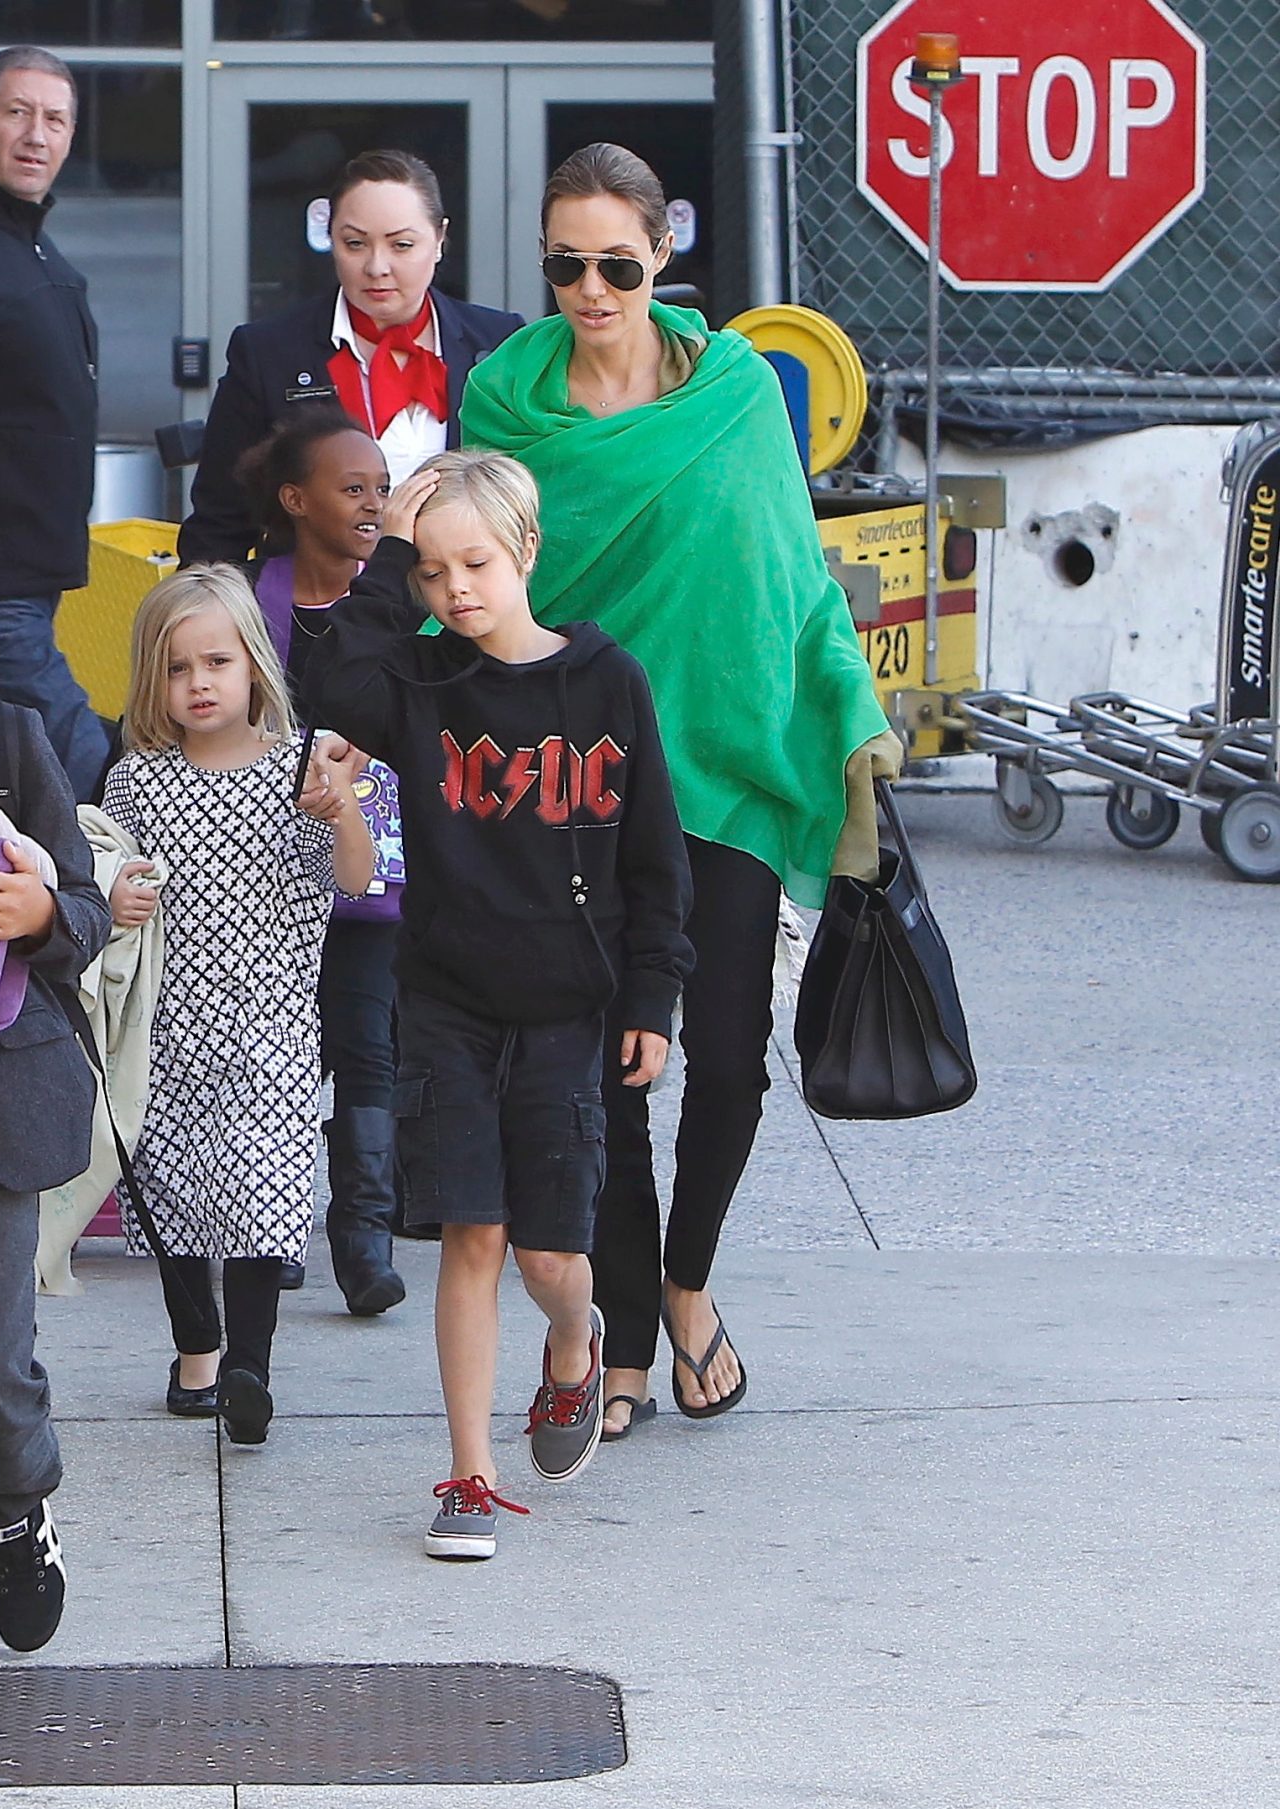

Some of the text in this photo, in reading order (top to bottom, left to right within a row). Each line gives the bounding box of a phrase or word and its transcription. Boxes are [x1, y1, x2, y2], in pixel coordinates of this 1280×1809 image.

[887, 55, 1177, 181] STOP
[1240, 484, 1277, 689] smartecarte
[876, 624, 909, 680] 20
